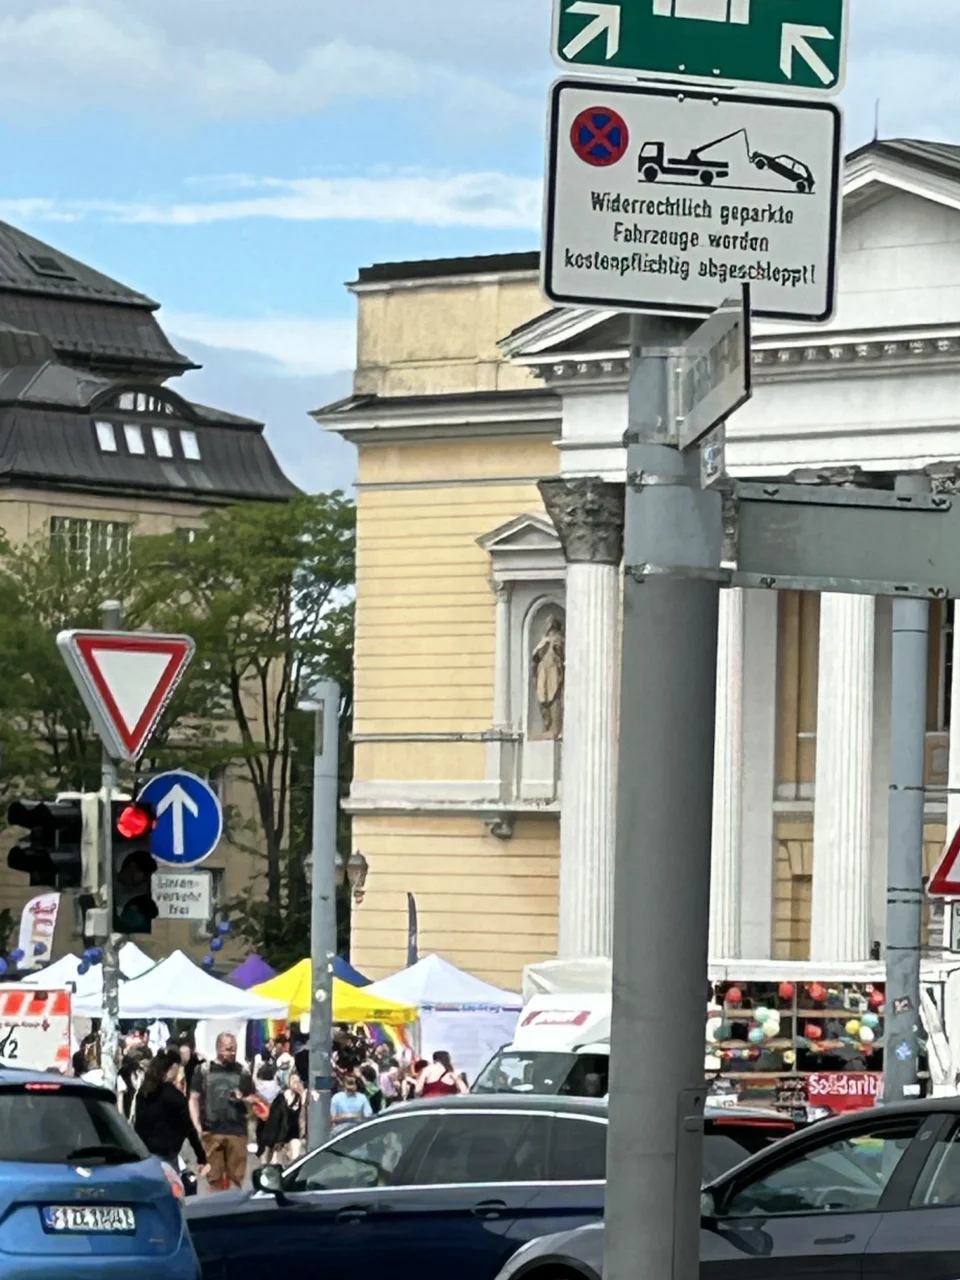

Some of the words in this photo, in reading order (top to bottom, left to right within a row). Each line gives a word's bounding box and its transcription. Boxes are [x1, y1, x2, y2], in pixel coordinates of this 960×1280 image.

[590, 191, 713, 219] Widerrechtlich
[720, 203, 794, 226] geparkte
[613, 221, 700, 252] Fahrzeuge
[708, 232, 770, 252] werden
[564, 248, 690, 281] kostenpflichtig
[698, 259, 816, 288] abgeschleppt!
